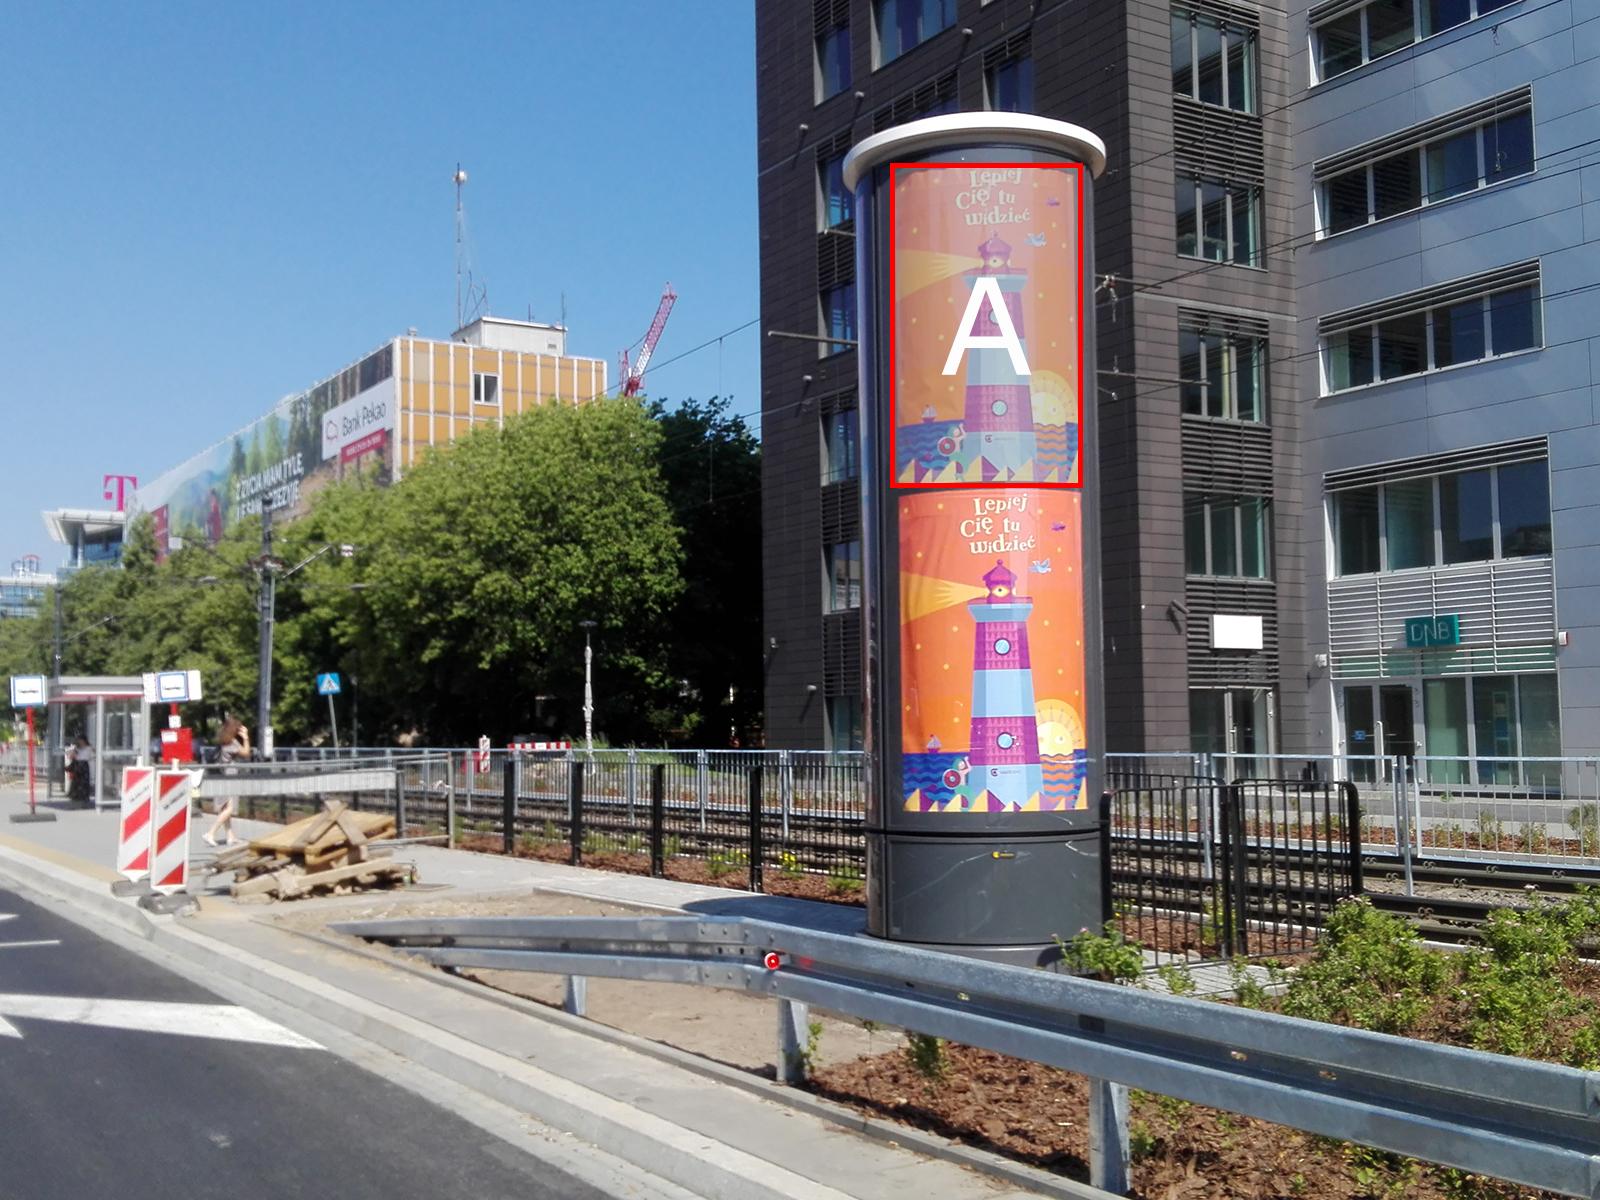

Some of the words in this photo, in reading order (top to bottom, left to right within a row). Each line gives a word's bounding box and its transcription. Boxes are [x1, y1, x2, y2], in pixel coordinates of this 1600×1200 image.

[969, 168, 1023, 189] Lepiej
[955, 188, 990, 210] Cię
[998, 189, 1017, 205] tu
[965, 205, 1032, 226] widzieć
[103, 475, 138, 512] T
[973, 493, 1029, 517] Lepiej
[960, 516, 993, 539] Cię
[1003, 517, 1021, 534] tu
[969, 533, 1036, 554] widzieć
[1410, 619, 1451, 647] DNB
